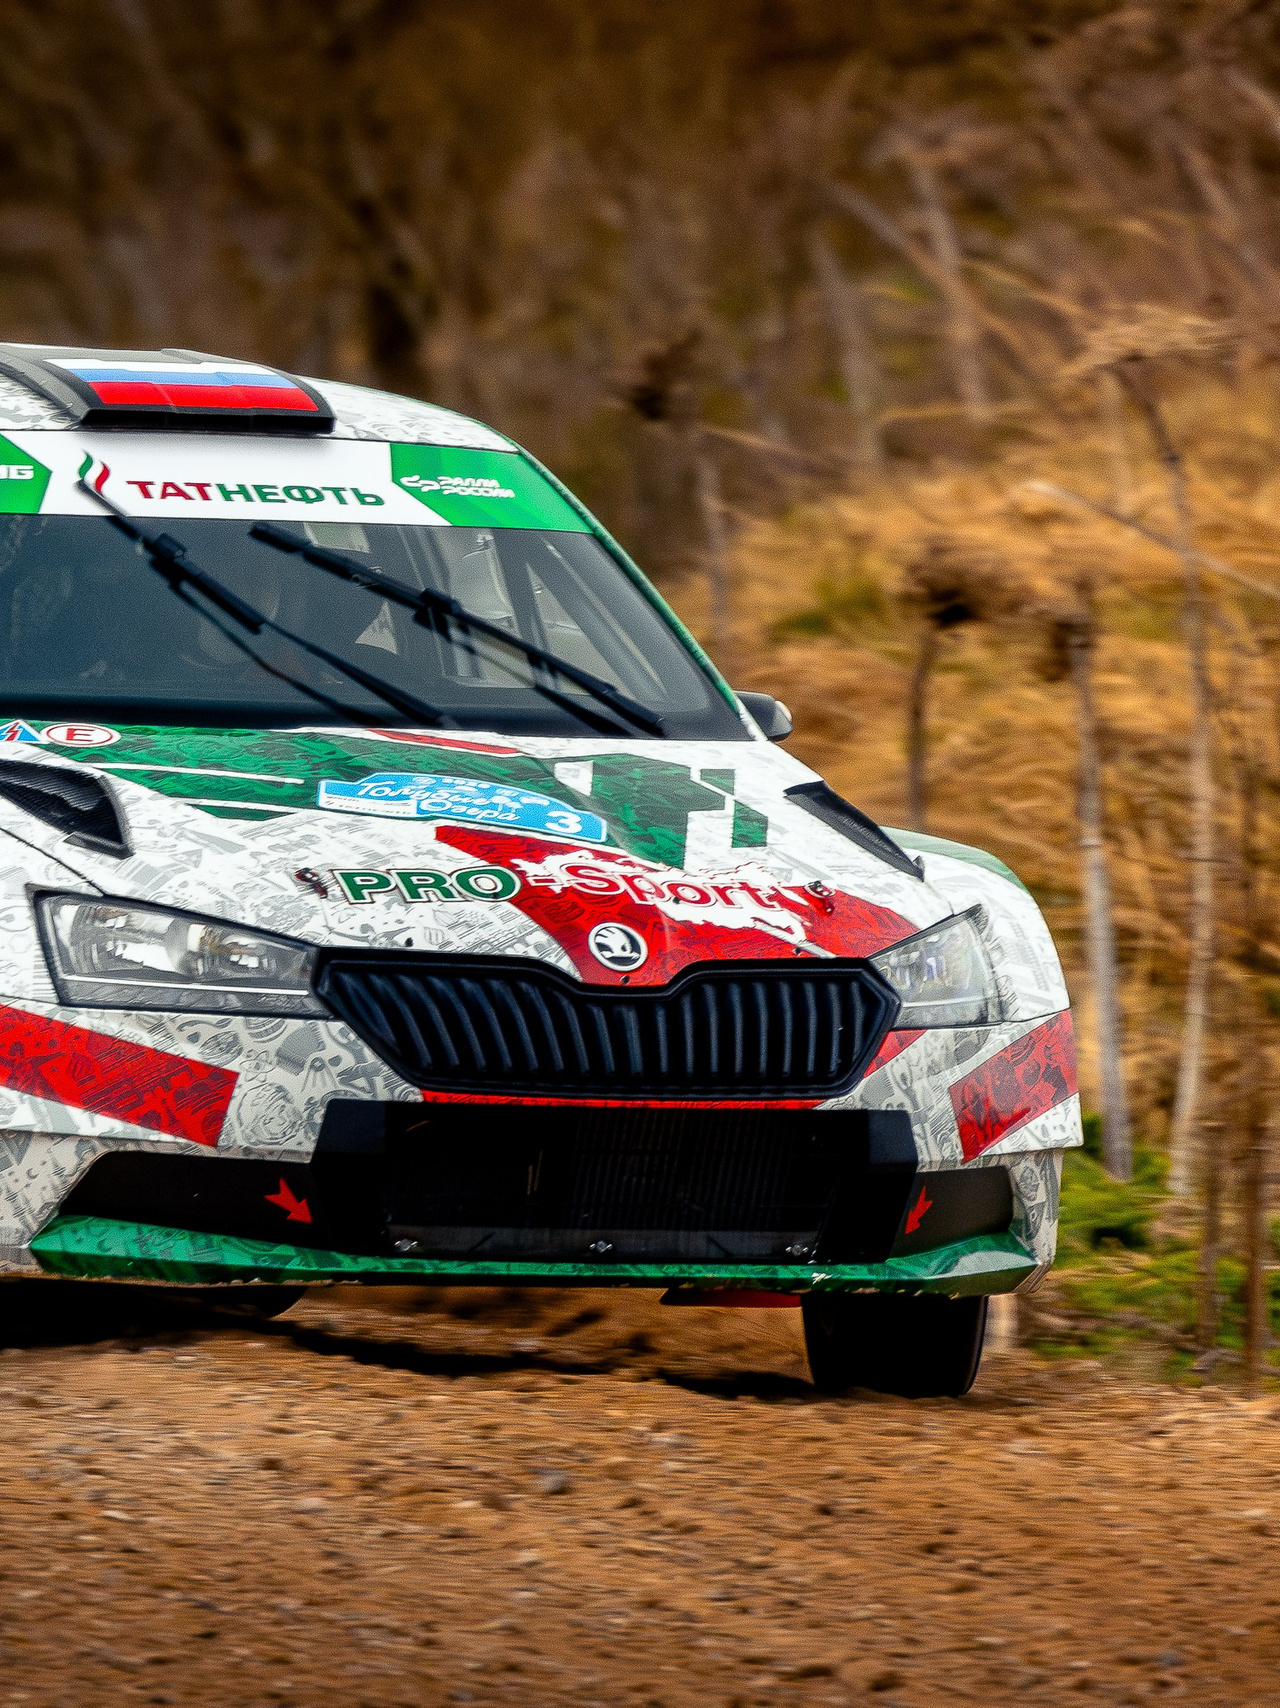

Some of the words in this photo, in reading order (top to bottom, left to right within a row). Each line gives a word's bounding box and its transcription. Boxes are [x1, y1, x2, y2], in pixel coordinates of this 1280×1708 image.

[125, 480, 386, 507] ТАТНЕФТЬ
[65, 727, 96, 742] E
[420, 799, 521, 822] Озера
[544, 810, 583, 834] 3
